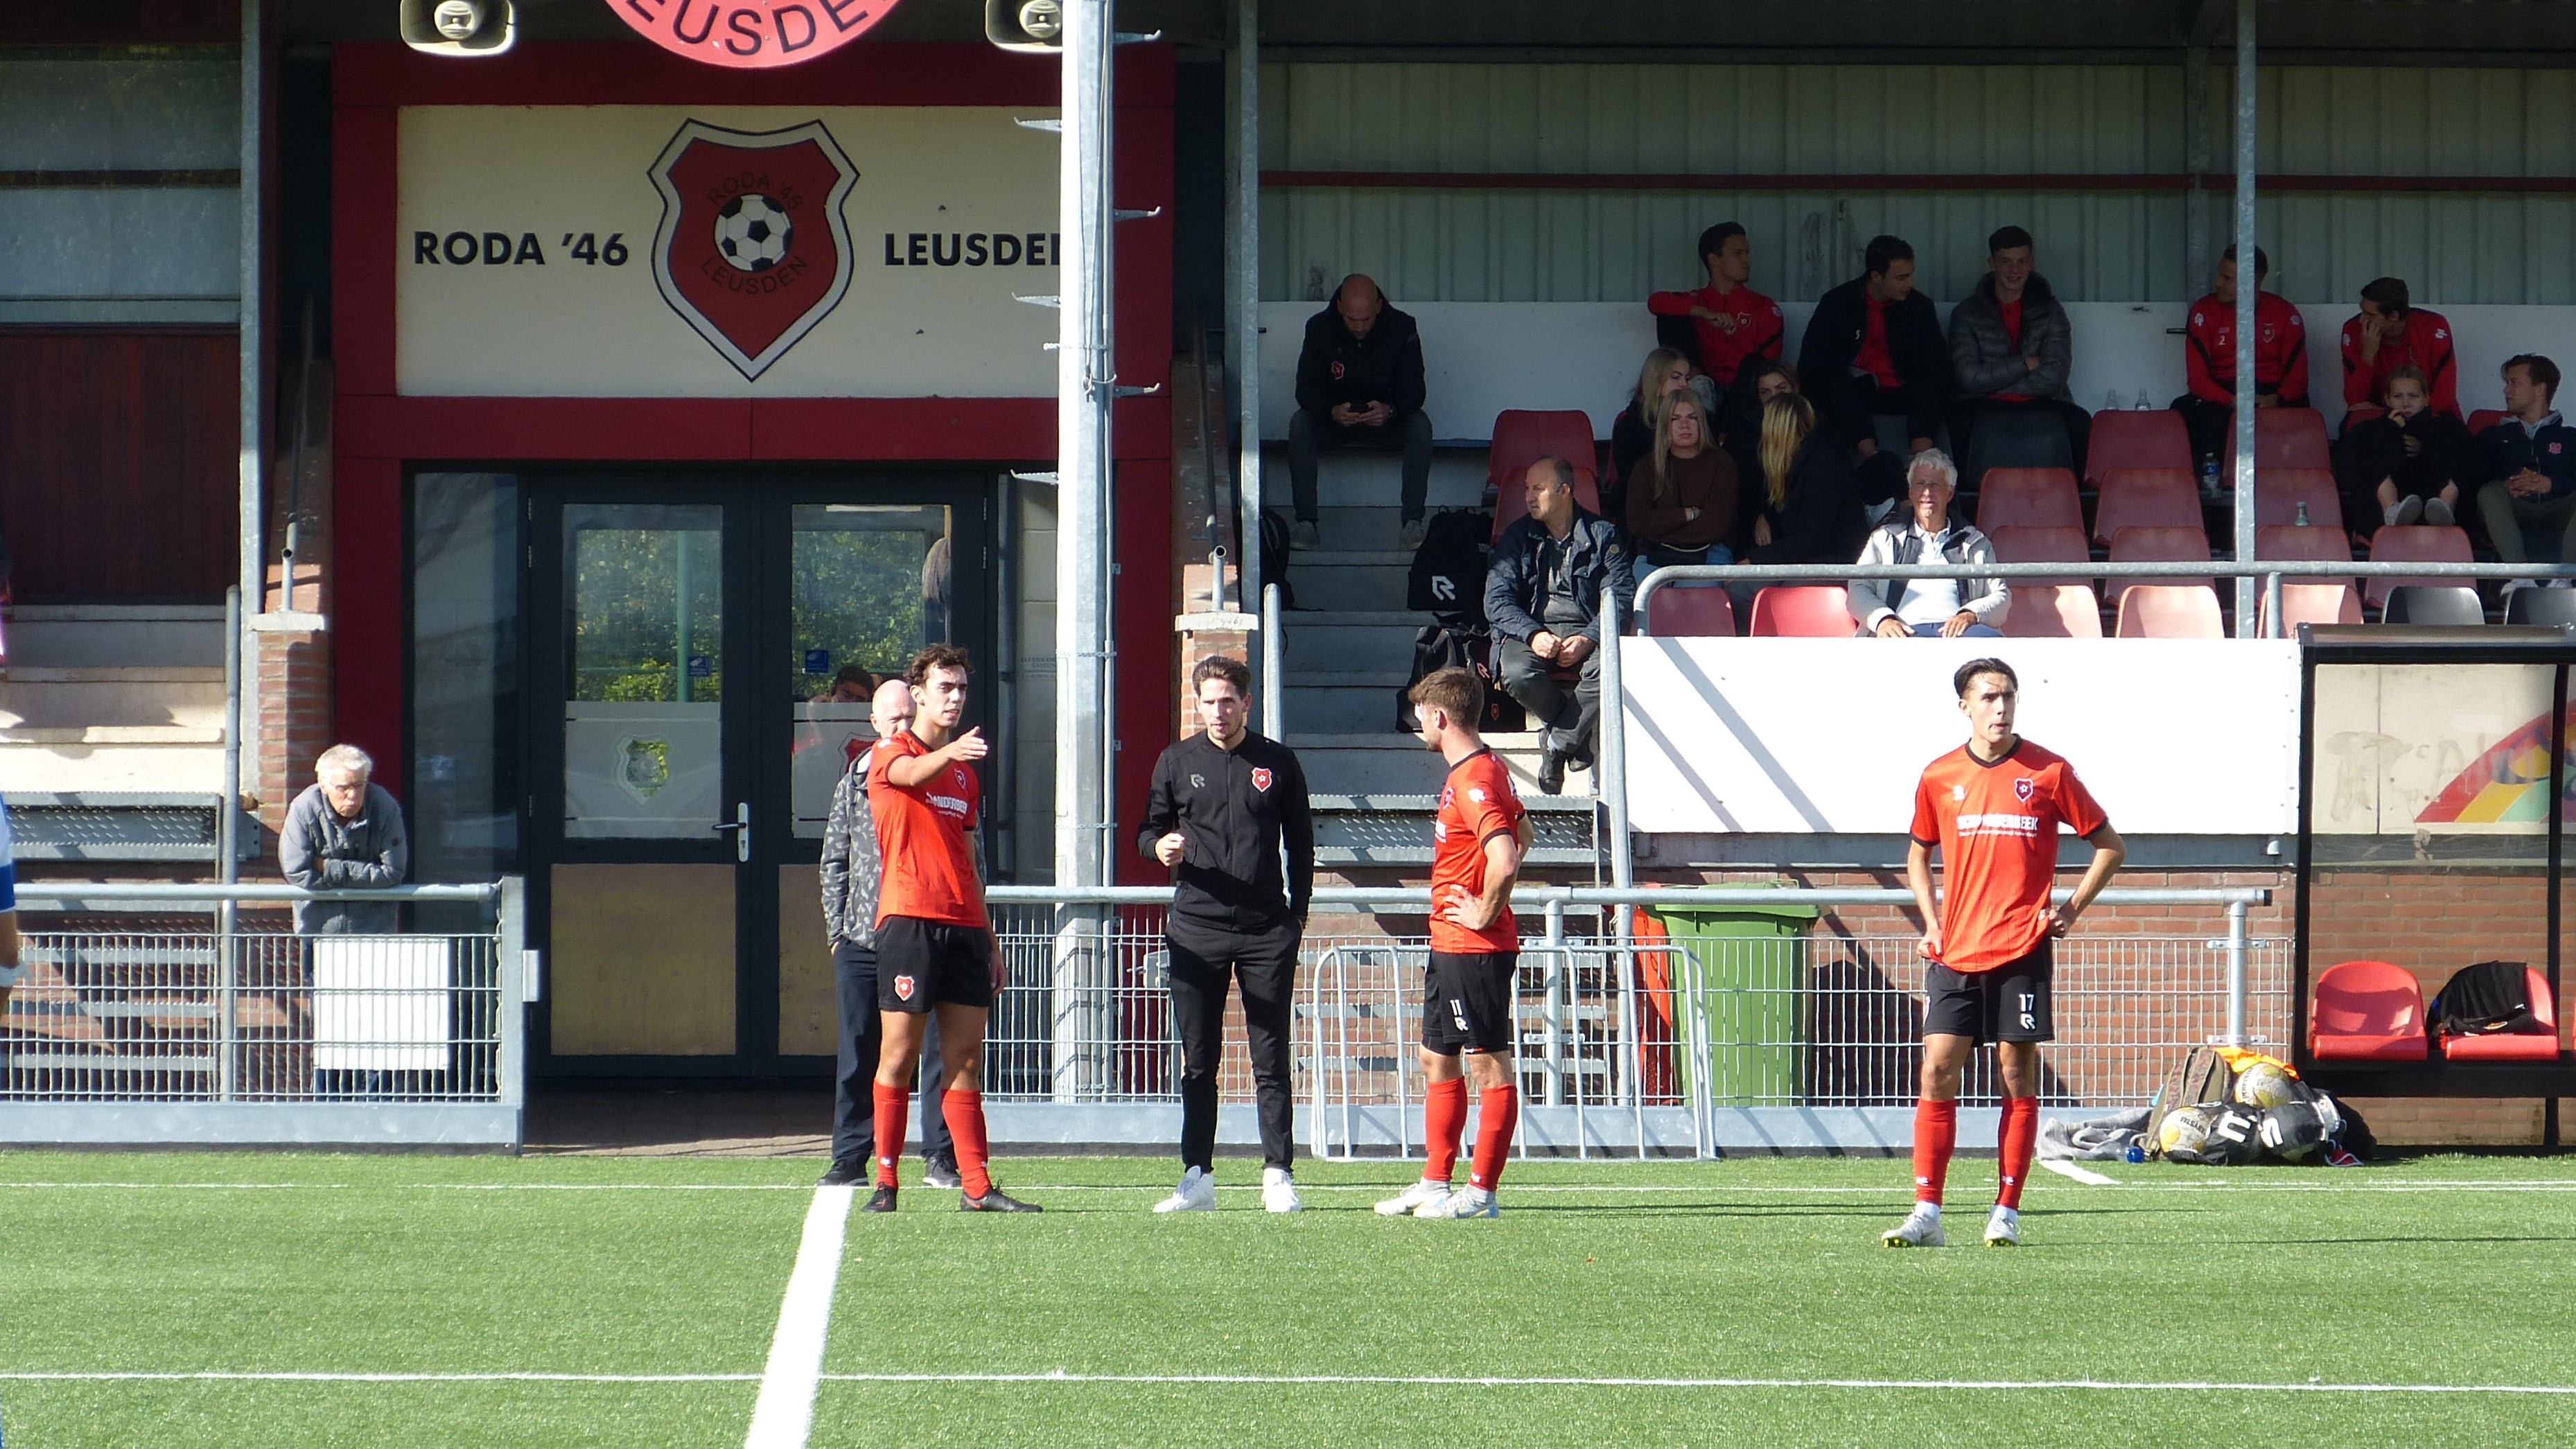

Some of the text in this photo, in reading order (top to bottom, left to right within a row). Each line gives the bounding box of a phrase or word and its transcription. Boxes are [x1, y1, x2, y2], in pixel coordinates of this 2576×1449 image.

[707, 171, 771, 206] RODA
[414, 231, 629, 266] RODA '46
[701, 255, 808, 294] LEUSDEN
[2218, 335, 2226, 346] 2
[1449, 999, 1463, 1017] 11
[2018, 993, 2035, 1012] 17
